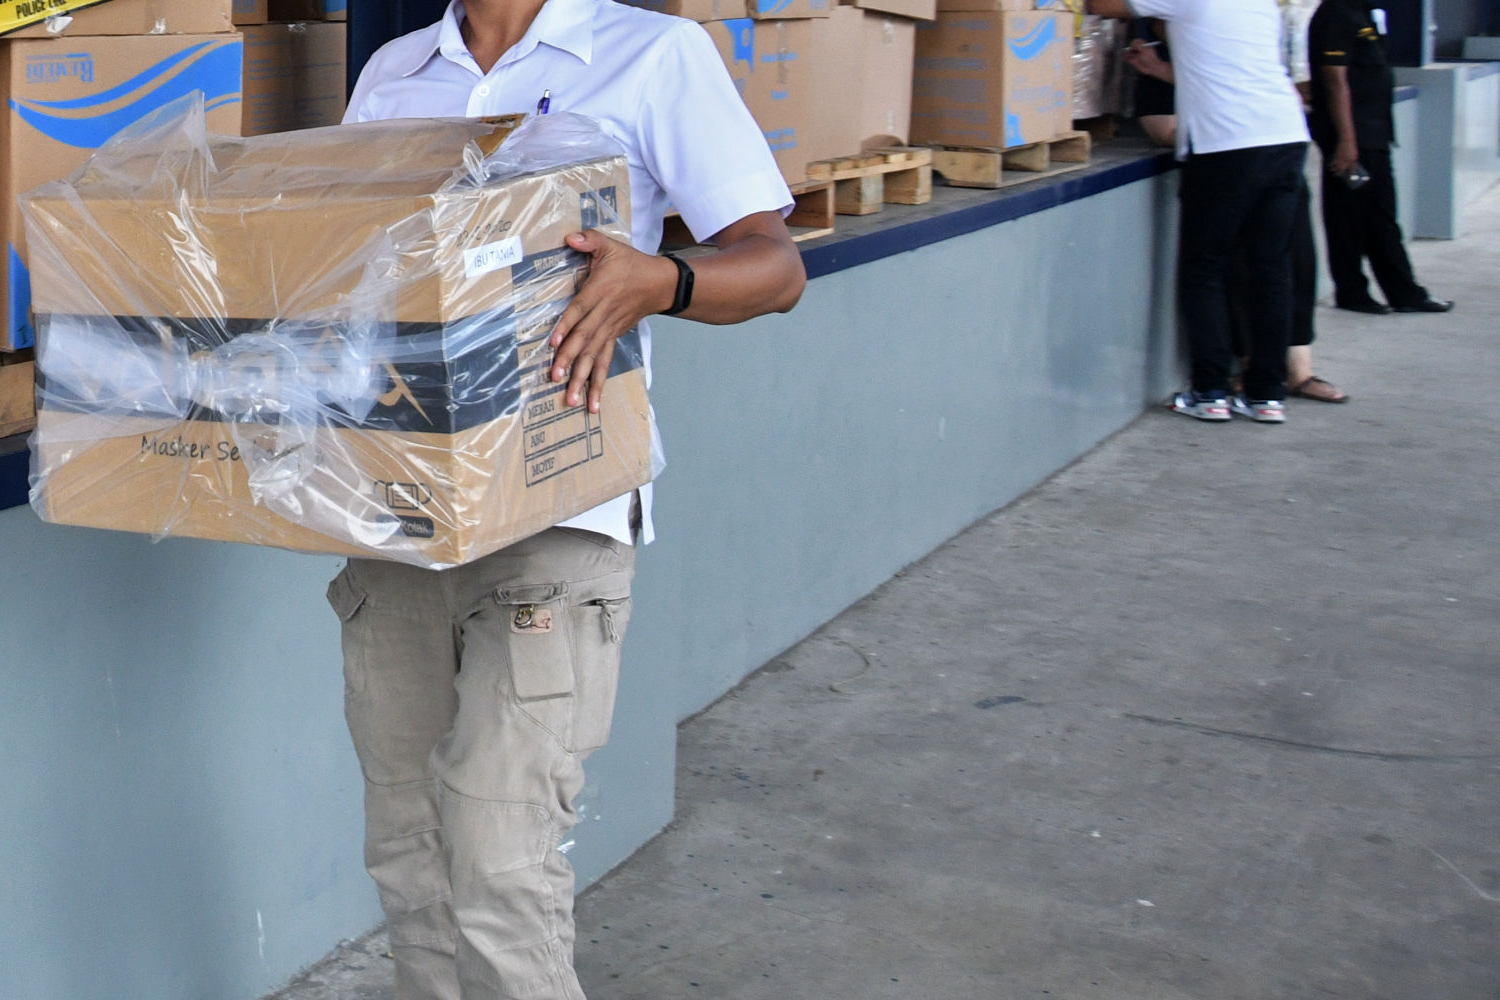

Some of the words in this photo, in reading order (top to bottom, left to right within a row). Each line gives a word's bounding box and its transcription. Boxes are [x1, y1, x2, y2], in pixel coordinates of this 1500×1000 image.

[527, 399, 555, 420] MERAH
[140, 436, 211, 461] Masker
[530, 431, 546, 448] ABU
[531, 457, 555, 478] MOTIF
